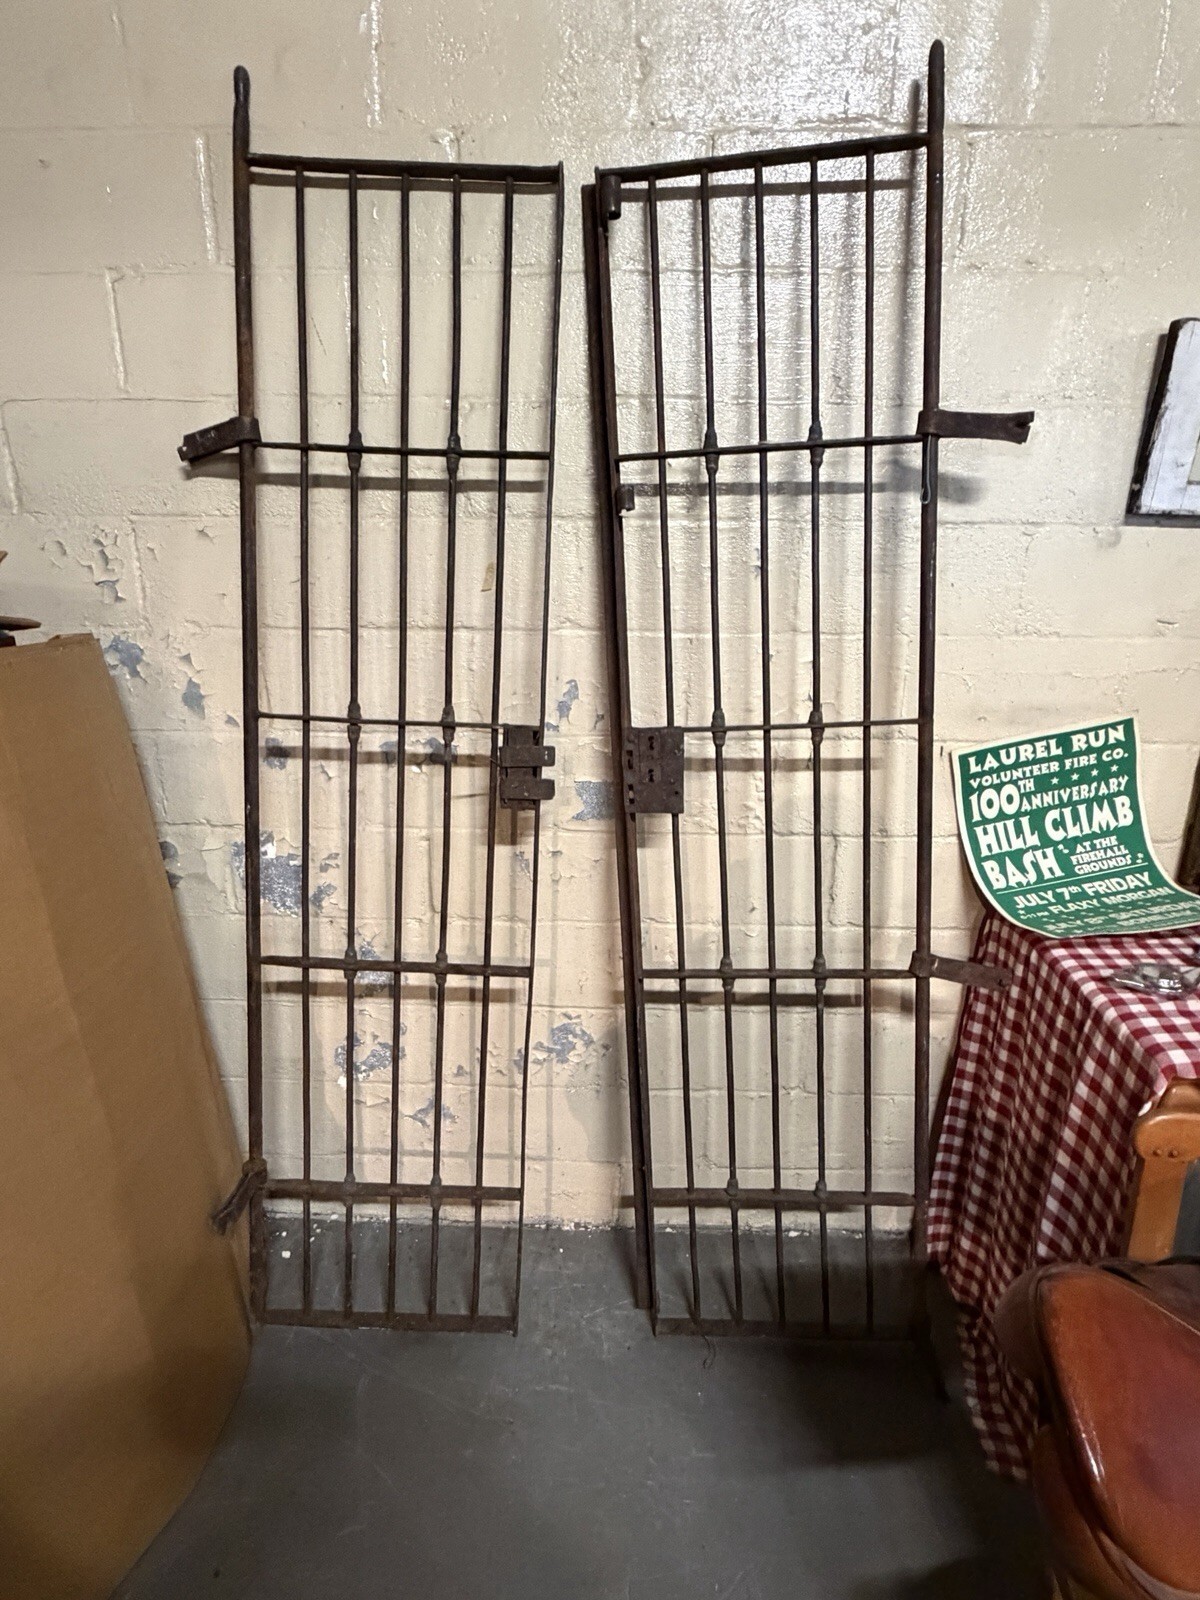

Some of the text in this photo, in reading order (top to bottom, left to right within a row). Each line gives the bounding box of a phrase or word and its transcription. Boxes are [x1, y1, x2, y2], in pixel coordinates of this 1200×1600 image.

[968, 724, 1125, 774] LAUREL RUN
[969, 748, 1128, 789] VOLUNTEER FIRE CO.
[1021, 775, 1129, 812] ANNIVERSARY
[973, 795, 1134, 857] HILL CLIMB
[1075, 835, 1118, 853] AT THE
[981, 846, 1065, 890] BASH
[1070, 845, 1129, 866] FIREHALL
[1074, 855, 1132, 875] GROUNDS
[1014, 890, 1056, 908] JULY
[1081, 871, 1152, 896] FRIDAY
[1048, 887, 1176, 914] FLAXY MORGAN
